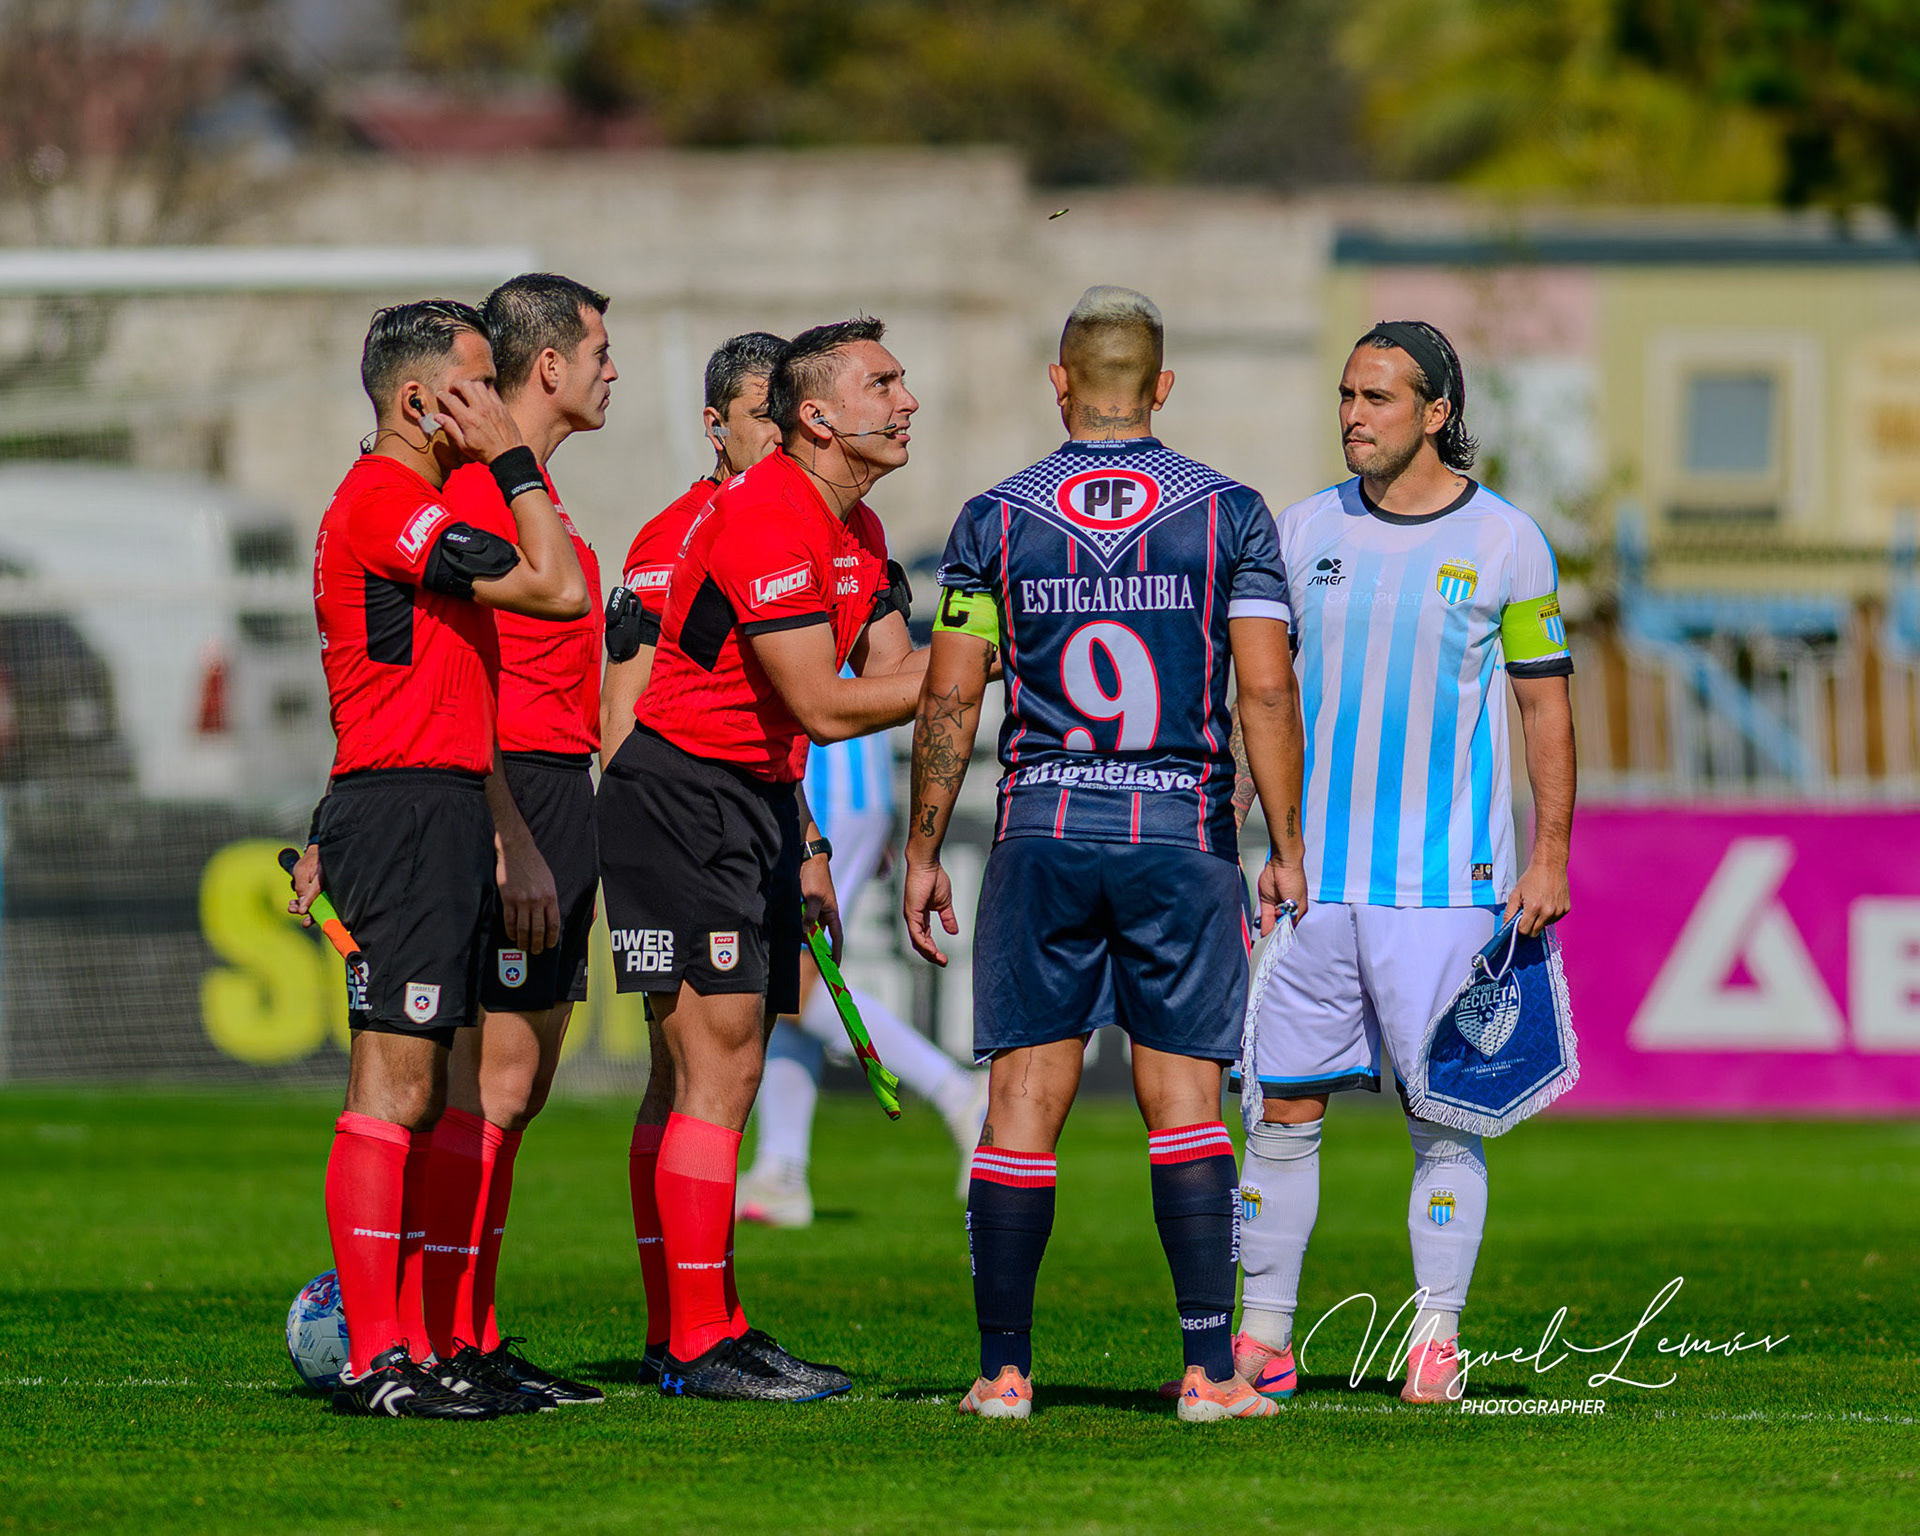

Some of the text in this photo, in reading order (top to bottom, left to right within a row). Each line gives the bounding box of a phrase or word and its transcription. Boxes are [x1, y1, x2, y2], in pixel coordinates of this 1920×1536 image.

[1084, 479, 1136, 519] PF
[399, 504, 444, 554] LANCO
[625, 570, 669, 592] LANCO
[755, 569, 808, 603] LANCO
[1020, 574, 1195, 614] ESTIGARRIBIA
[1060, 620, 1161, 751] 9
[1019, 762, 1198, 792] Miguelayo
[626, 950, 674, 972] ADE
